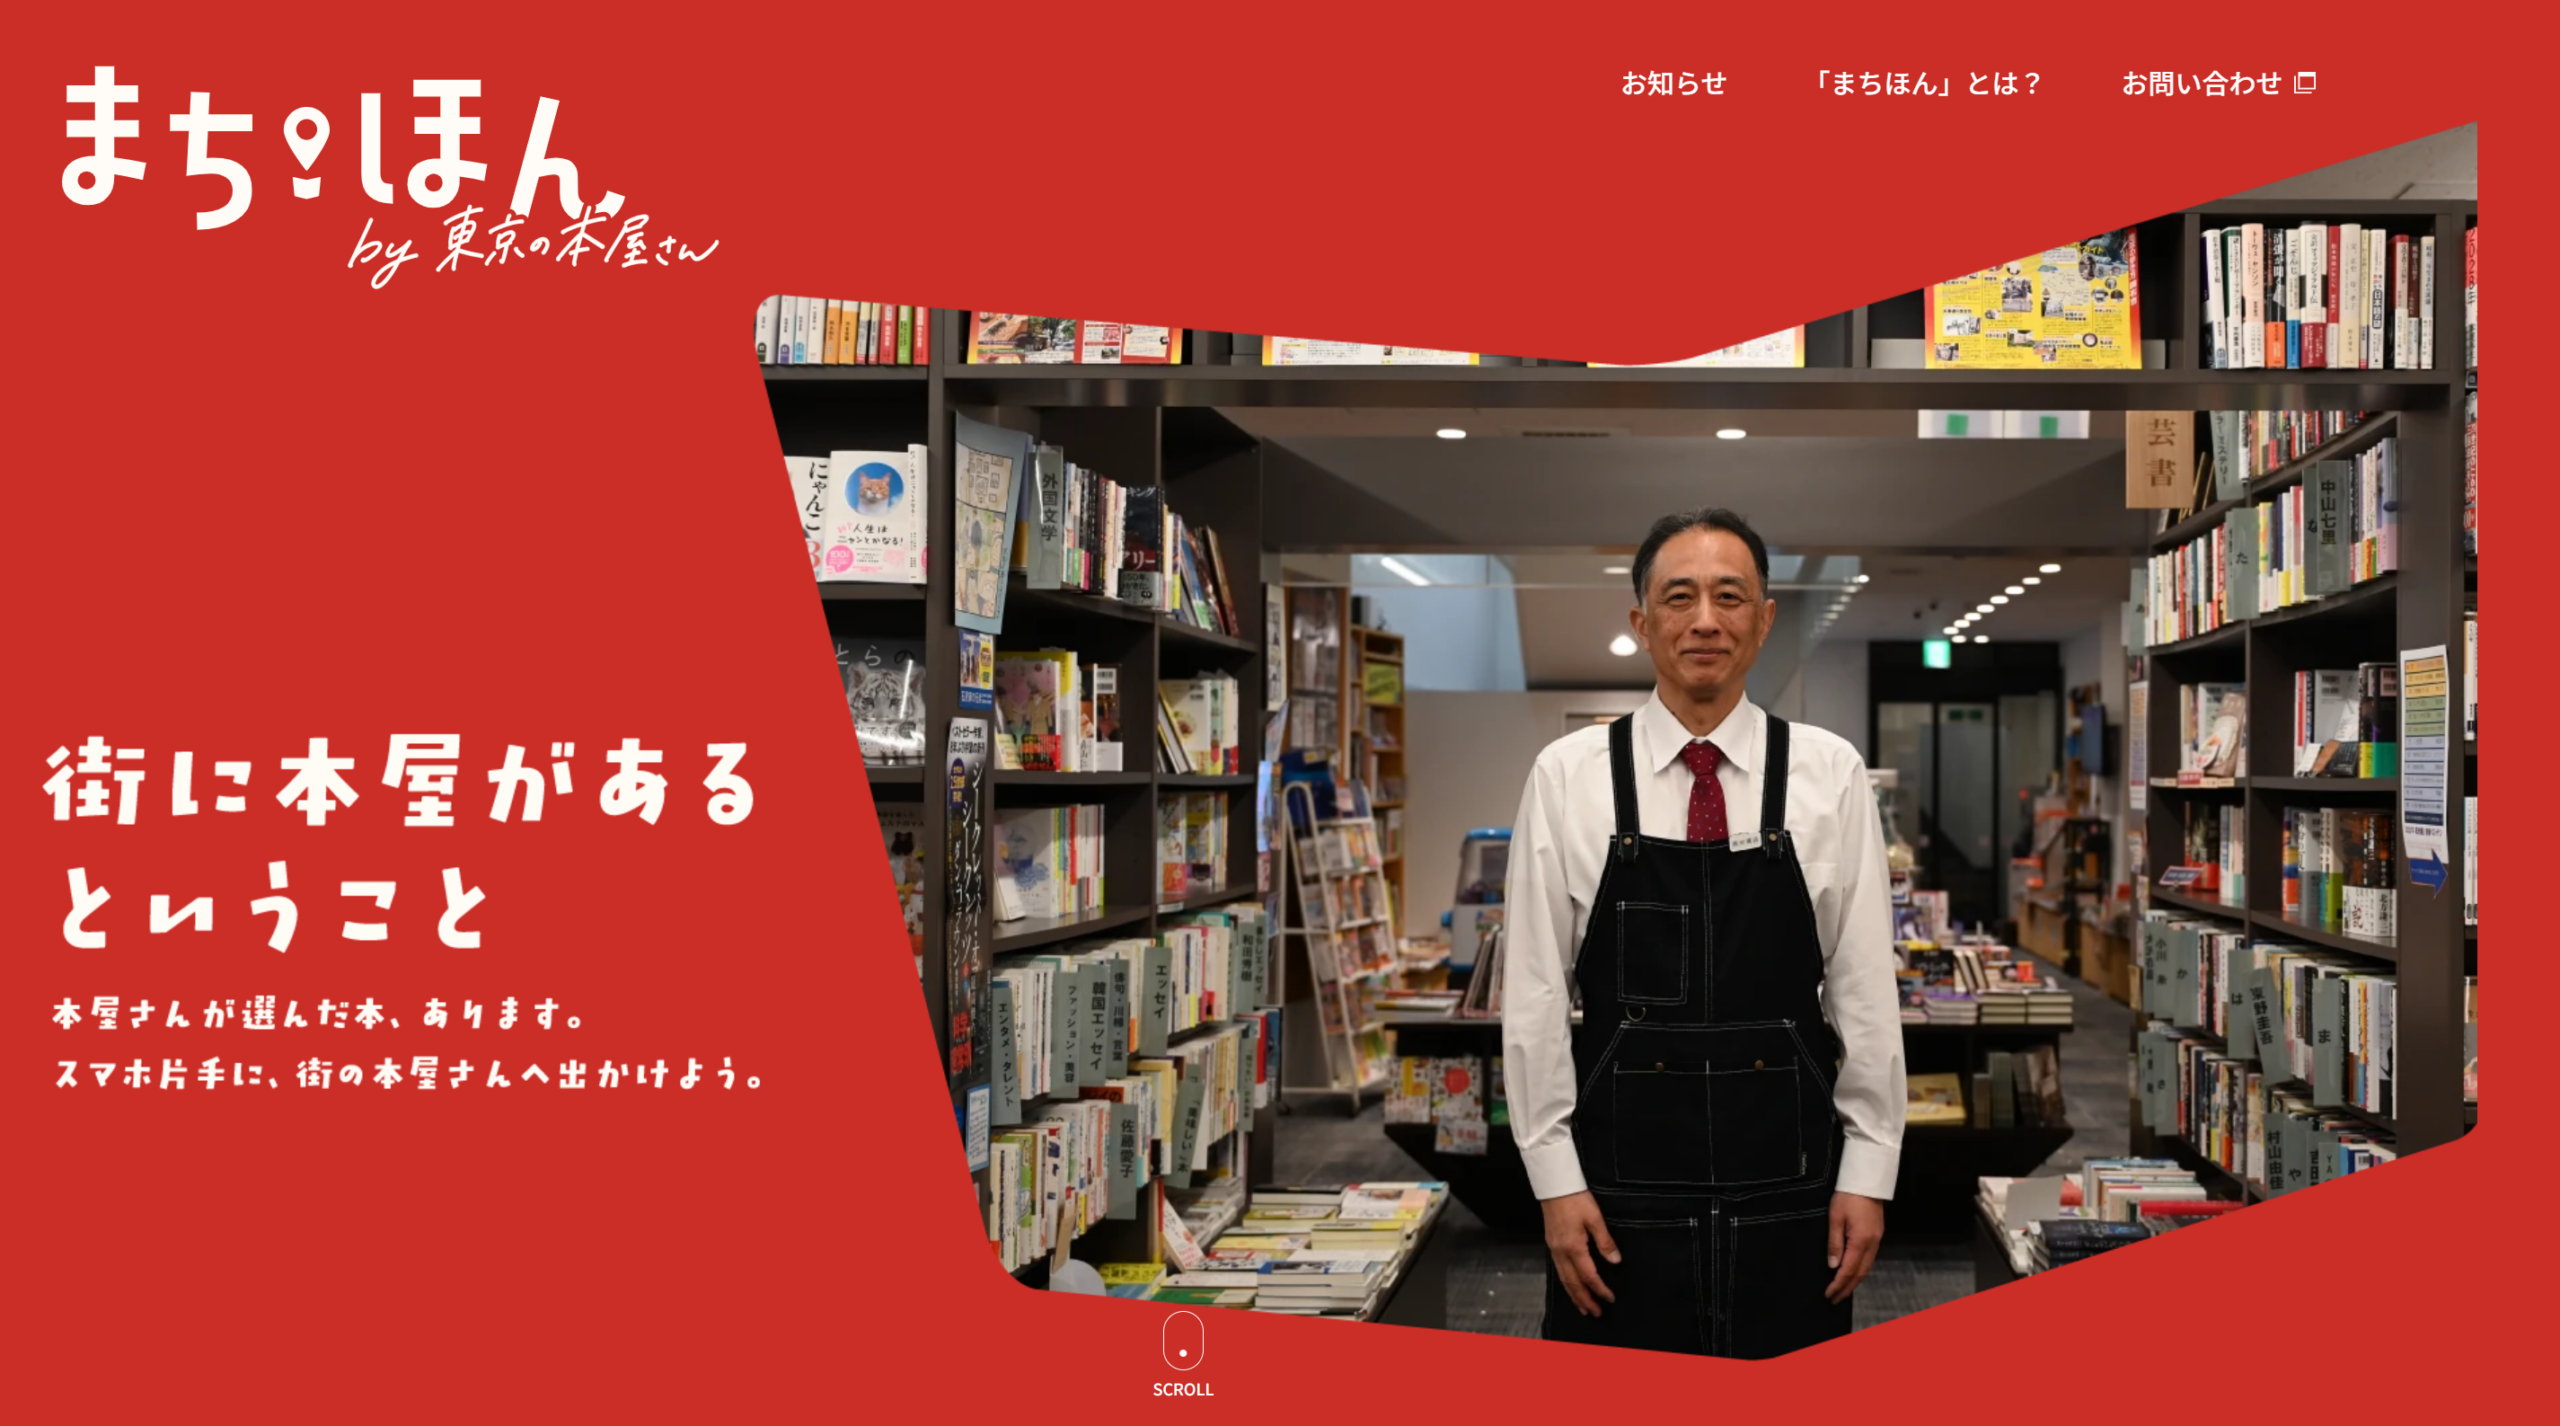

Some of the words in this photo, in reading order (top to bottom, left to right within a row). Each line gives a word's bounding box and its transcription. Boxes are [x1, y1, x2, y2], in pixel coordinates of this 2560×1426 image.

[806, 461, 828, 531] にゃんこ
[1041, 473, 1058, 542] 外国文学
[2321, 480, 2337, 545] 中山七里
[2236, 552, 2249, 564] た
[1241, 935, 1254, 982] 和田秀樹
[2176, 968, 2188, 979] か
[1112, 972, 1125, 1062] 俳句・川柳・言葉
[1154, 965, 1167, 1019] エッセイ
[2231, 994, 2243, 1006] は
[2250, 986, 2274, 1045] 東野圭吾
[998, 1003, 1015, 1107] エンタメ・タレント
[1064, 986, 1078, 1083] ファッション・美容
[1090, 982, 1106, 1071] 韓国エッセイ
[2318, 1029, 2331, 1044] ま
[1120, 1120, 1135, 1178] 佐藤愛子
[2267, 1130, 2284, 1190] 村山由佳
[2289, 1168, 2302, 1180] や
